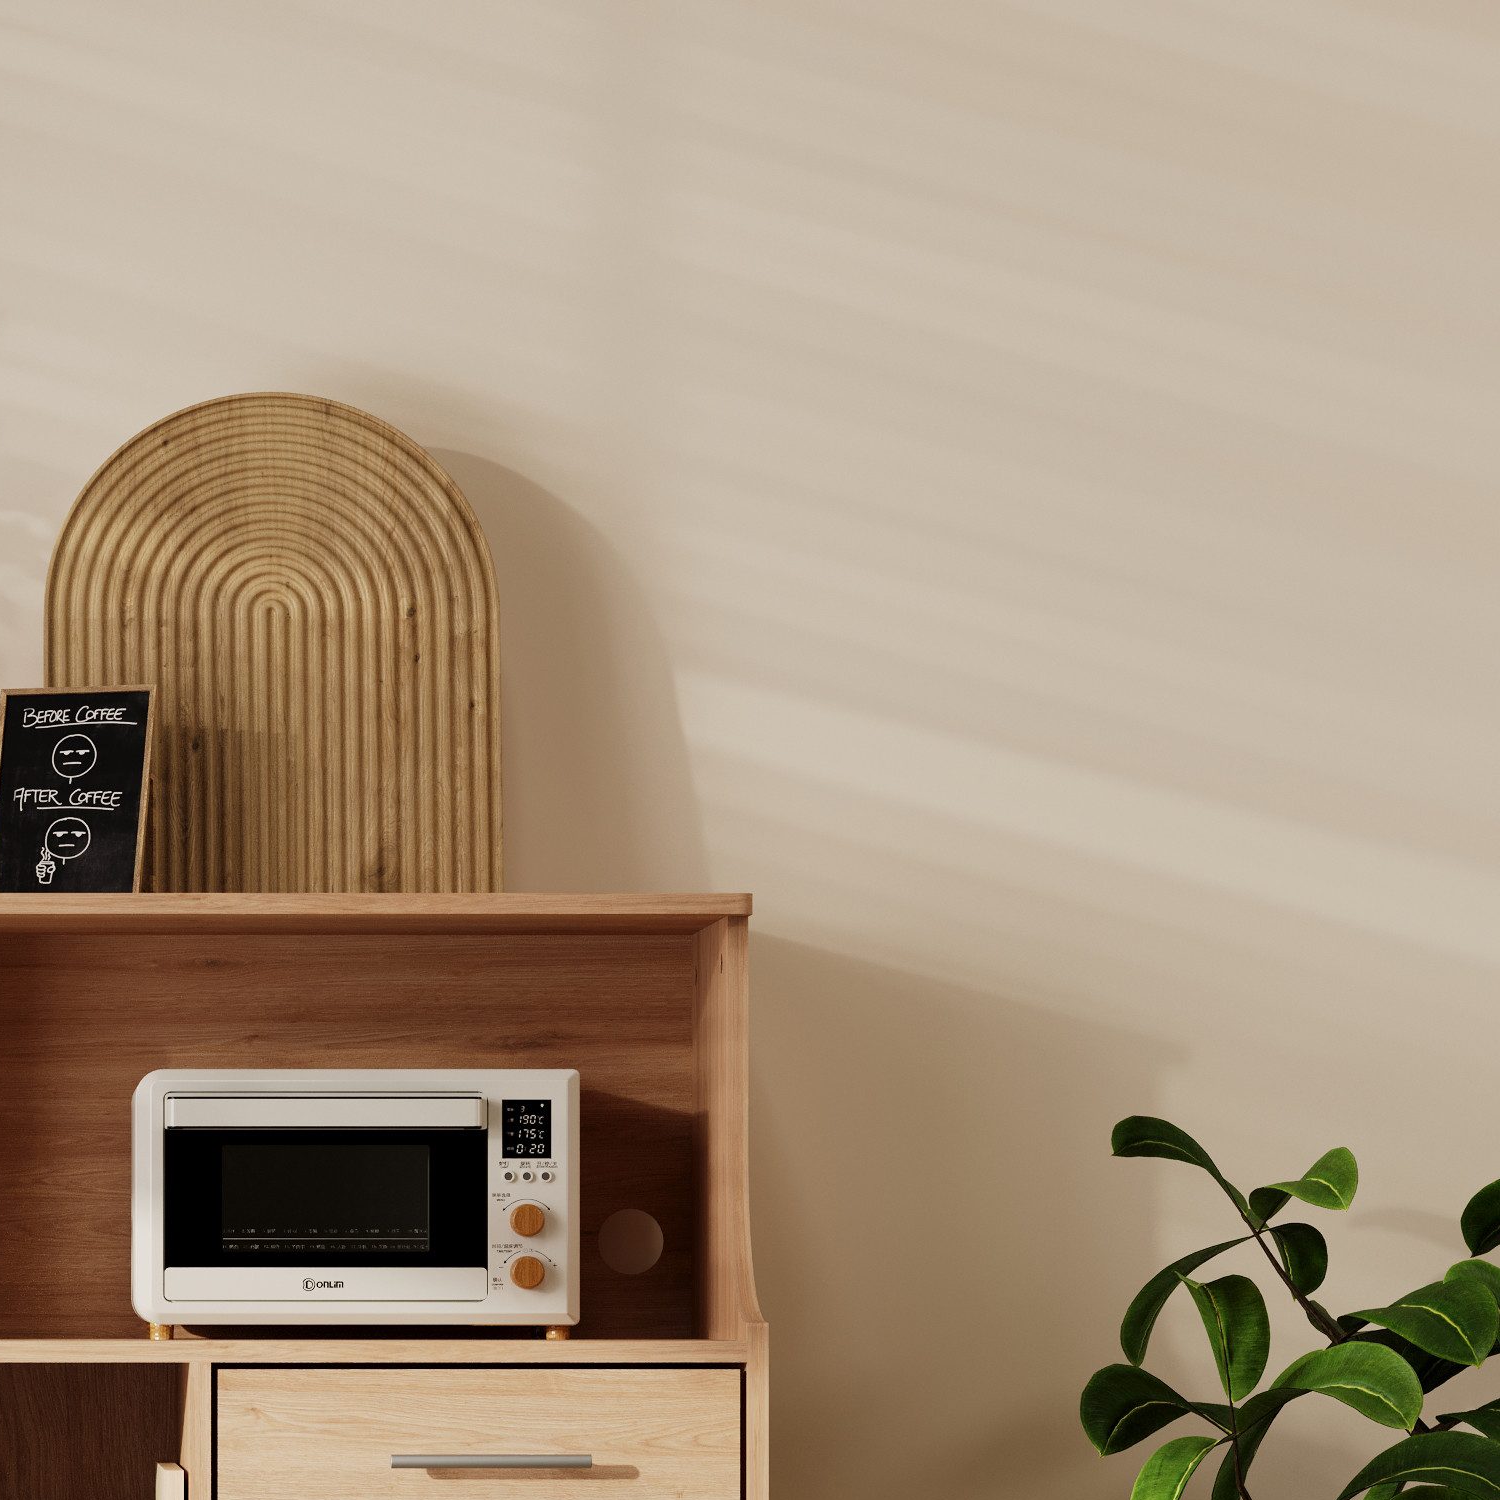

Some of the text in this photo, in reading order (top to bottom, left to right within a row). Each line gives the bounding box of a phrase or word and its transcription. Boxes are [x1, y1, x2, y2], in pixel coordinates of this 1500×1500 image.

[23, 706, 126, 727] BEFORE COFFEE
[13, 787, 123, 811] AFTER COFFEE
